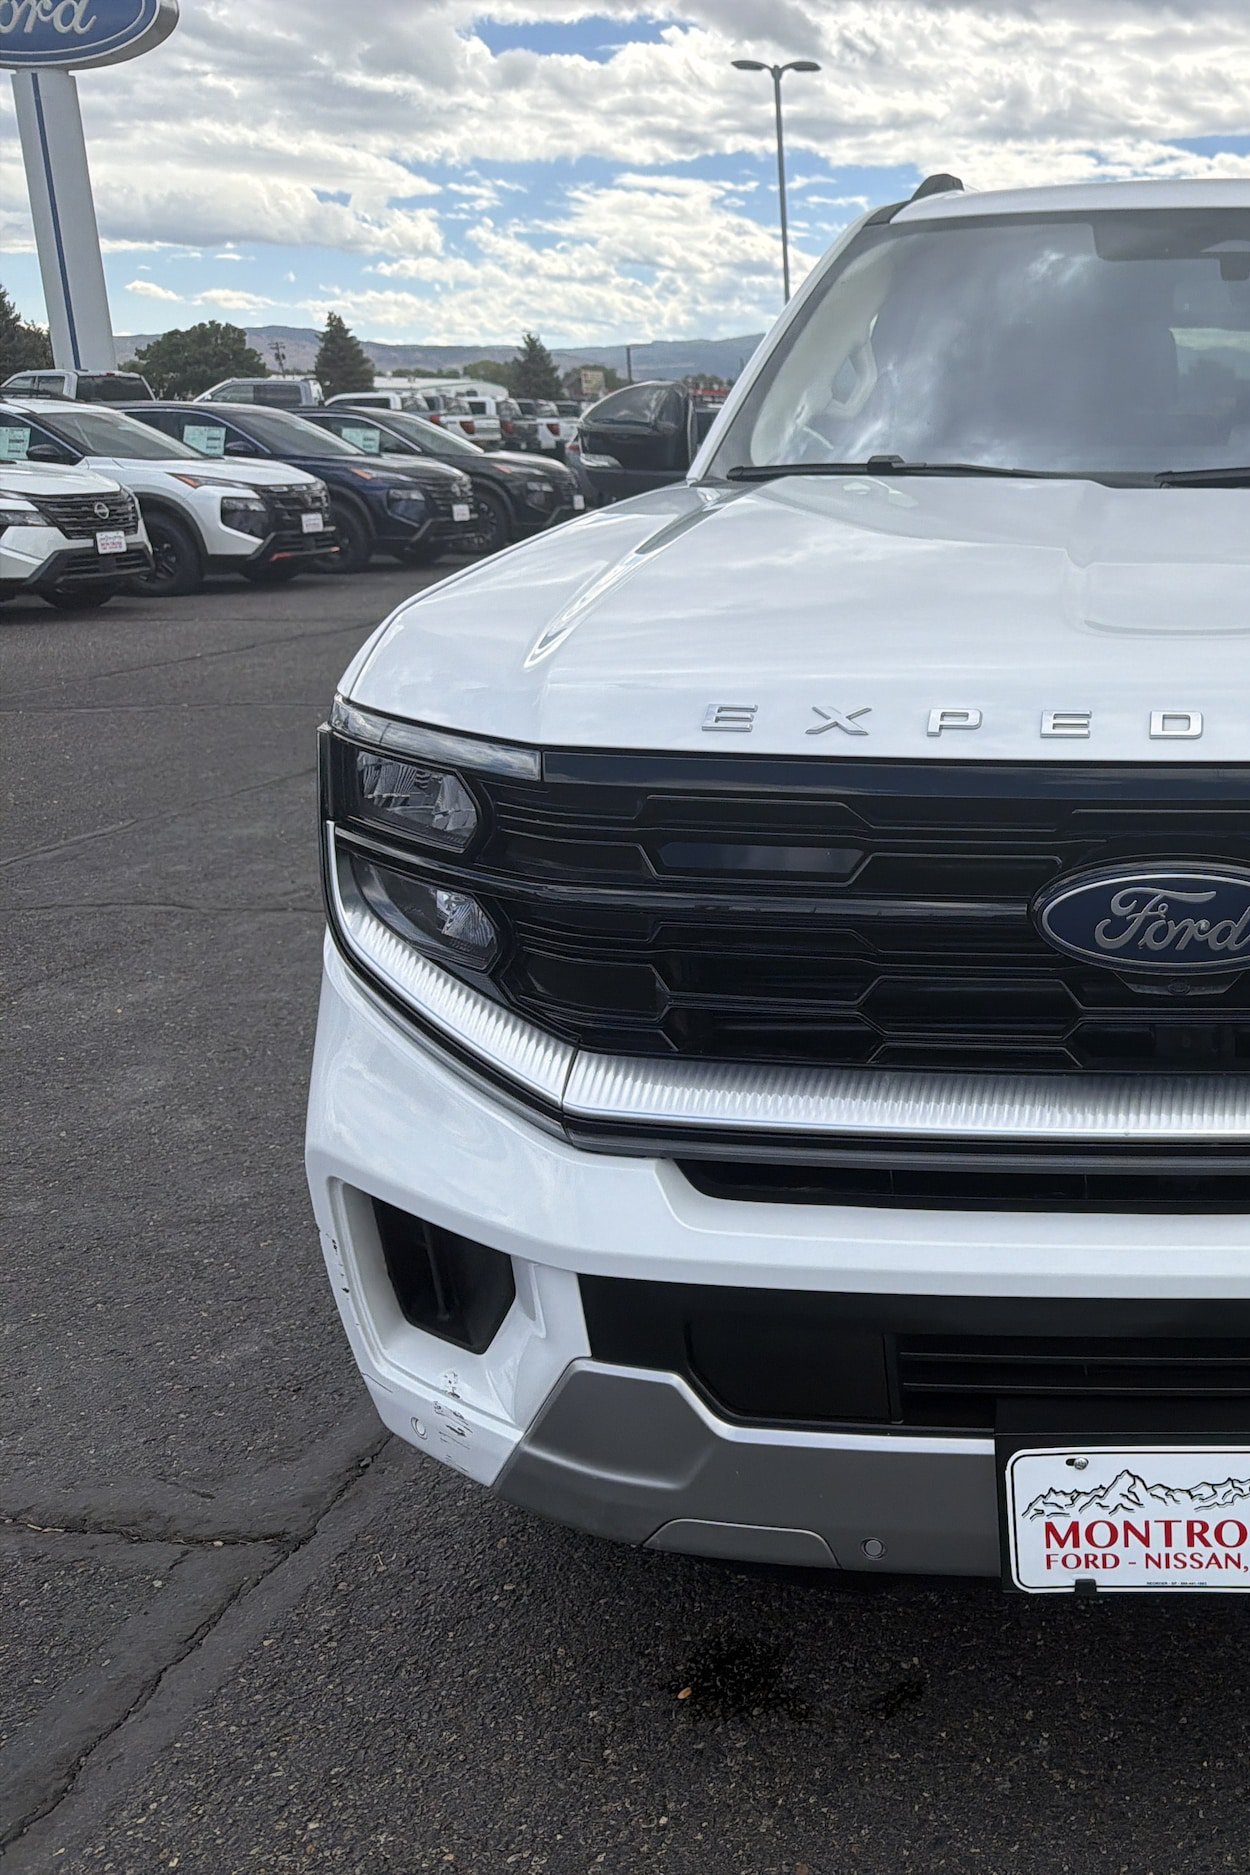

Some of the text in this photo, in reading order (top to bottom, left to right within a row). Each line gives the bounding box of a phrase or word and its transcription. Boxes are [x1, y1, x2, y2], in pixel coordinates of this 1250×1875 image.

[0, 0, 97, 35] ord
[1045, 1553, 1120, 1570] FORD
[1144, 1553, 1249, 1572] NISSAN,
